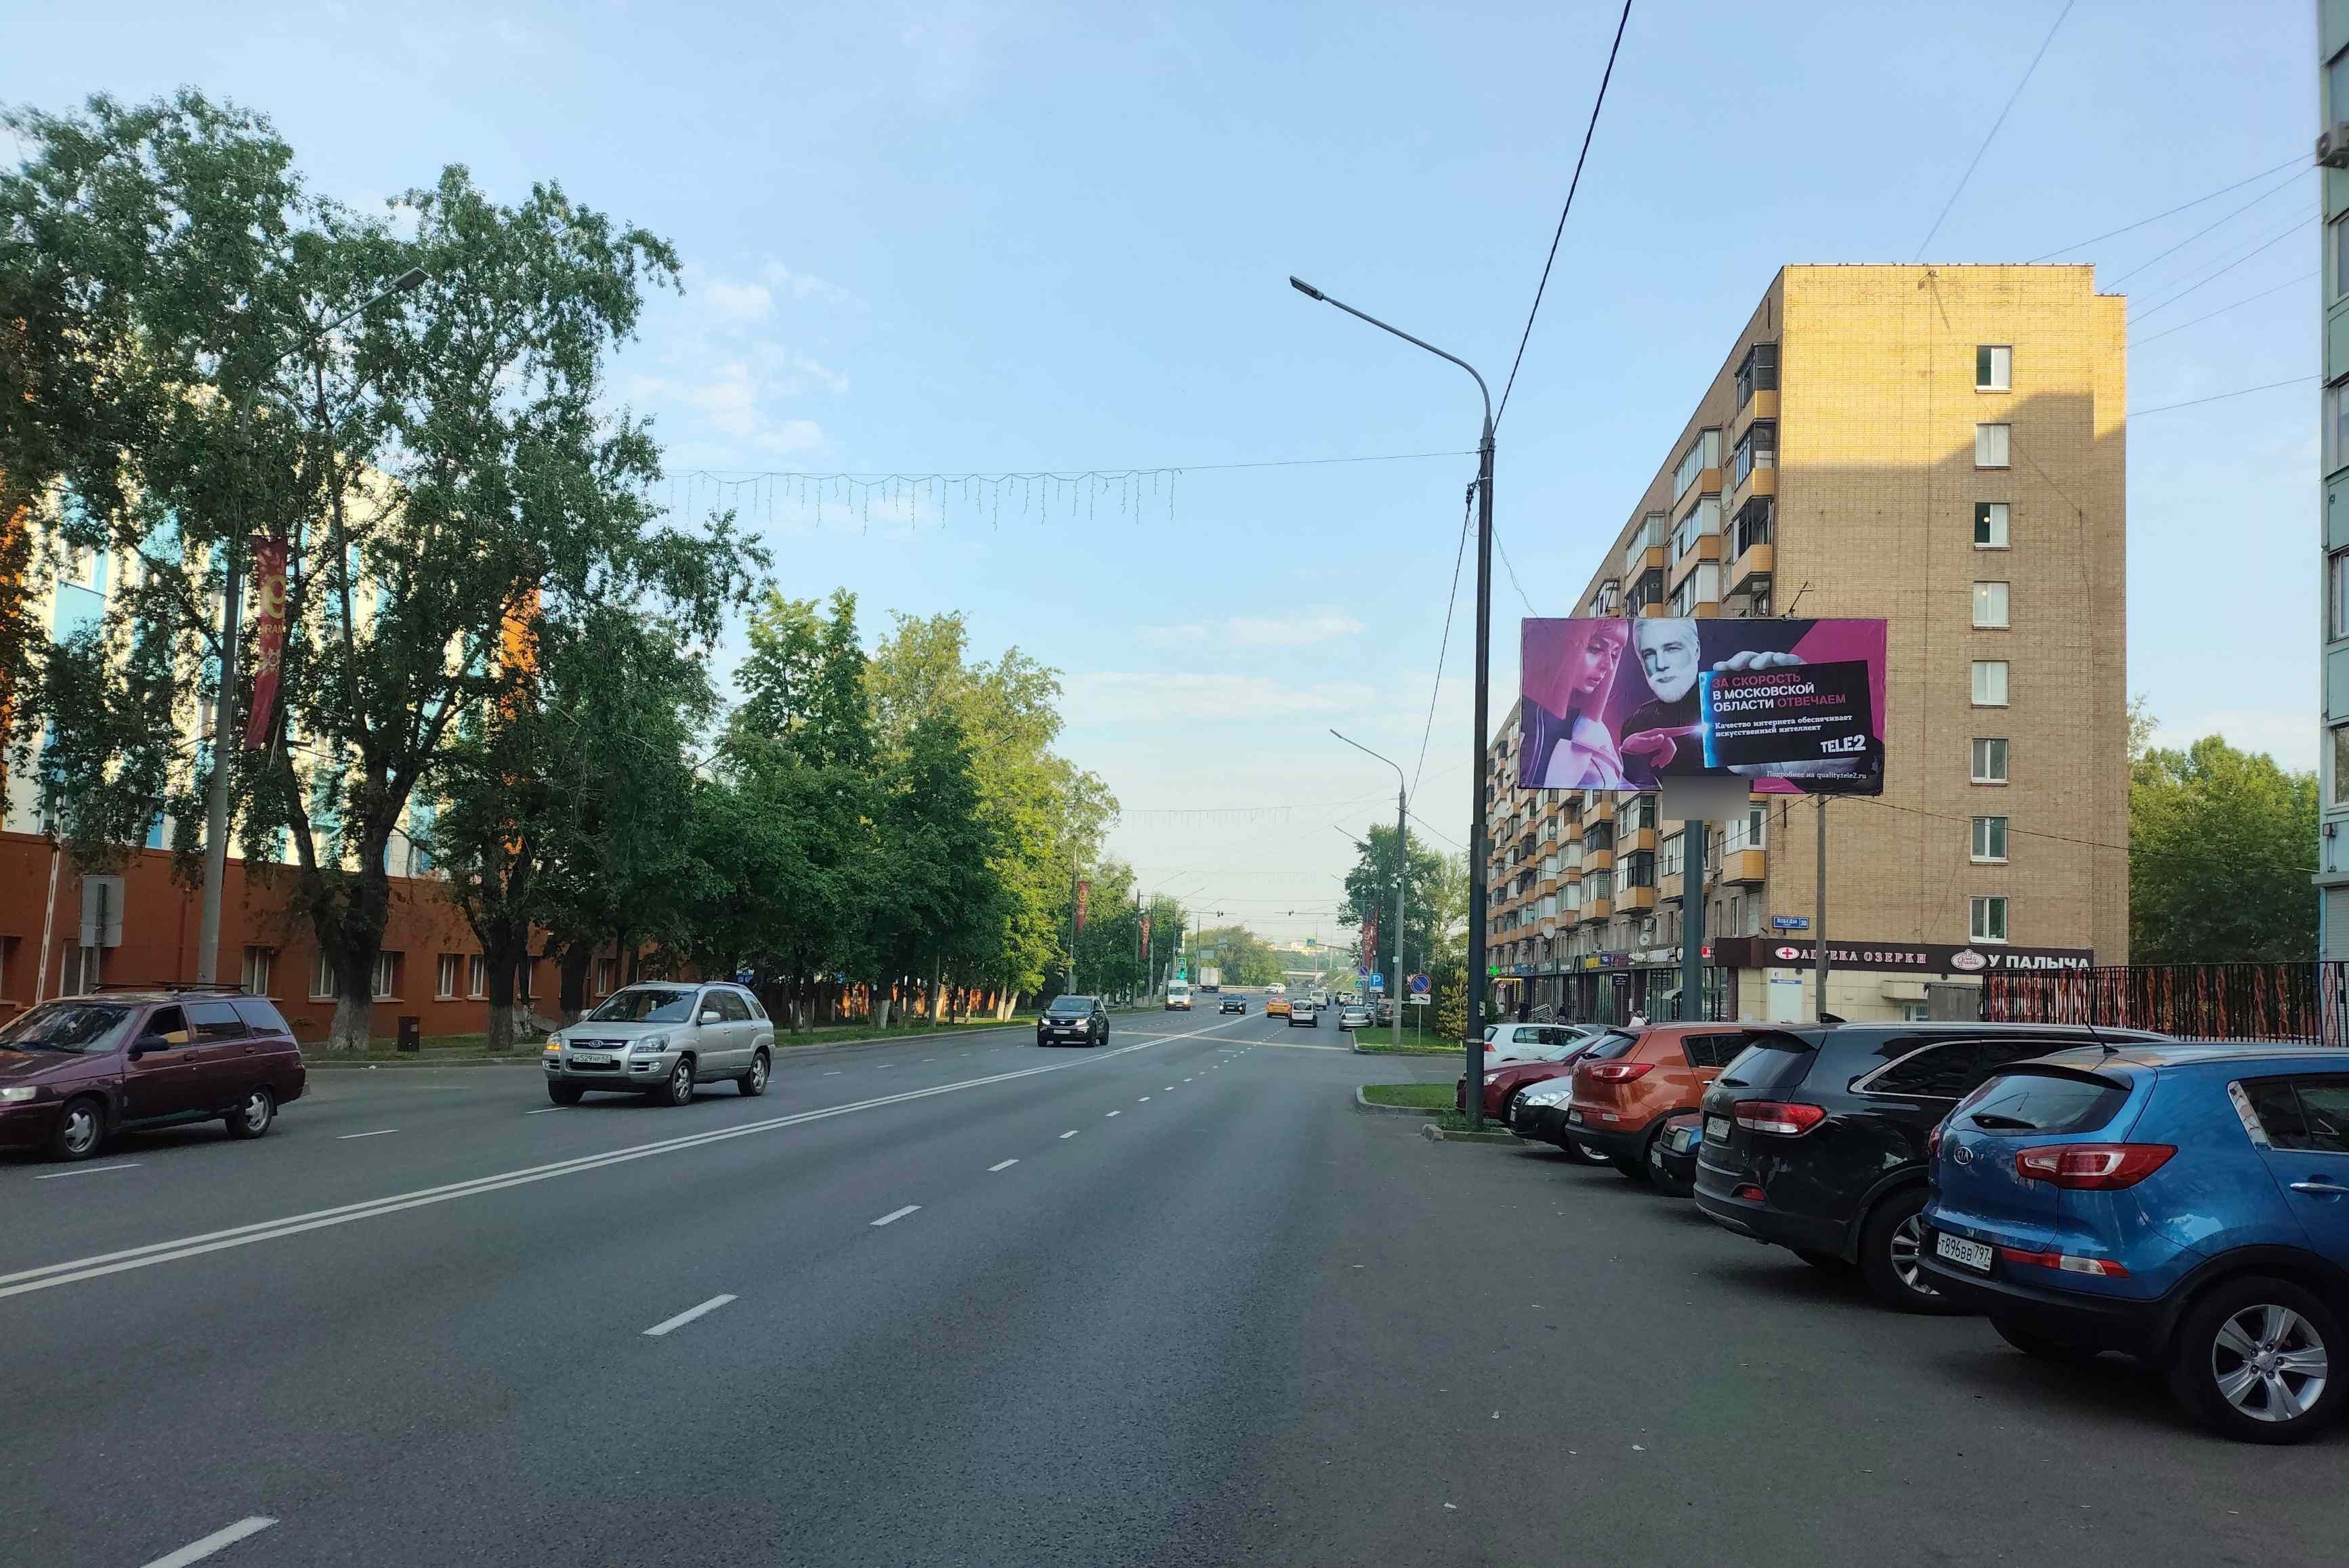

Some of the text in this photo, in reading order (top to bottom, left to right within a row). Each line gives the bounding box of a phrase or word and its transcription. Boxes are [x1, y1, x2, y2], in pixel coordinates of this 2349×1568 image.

[1712, 673, 1801, 688] ЗА СКОРОСТЬ
[1713, 682, 1815, 700] В МОСКОВСКОЙ
[1713, 694, 1846, 713] ОБЛАСТИ ОТВЕЧАЕМ
[1715, 714, 1853, 729] Качество интернета обеспечивает
[1716, 724, 1821, 738] искусственный интеллект
[1820, 734, 1866, 753] TELE2
[1766, 770, 1804, 779] Подробнее
[1800, 949, 1927, 964] АПЕКА ОЗЕРКИ
[1987, 954, 2001, 967] У
[2006, 955, 2090, 971] ПАЛЫЧА
